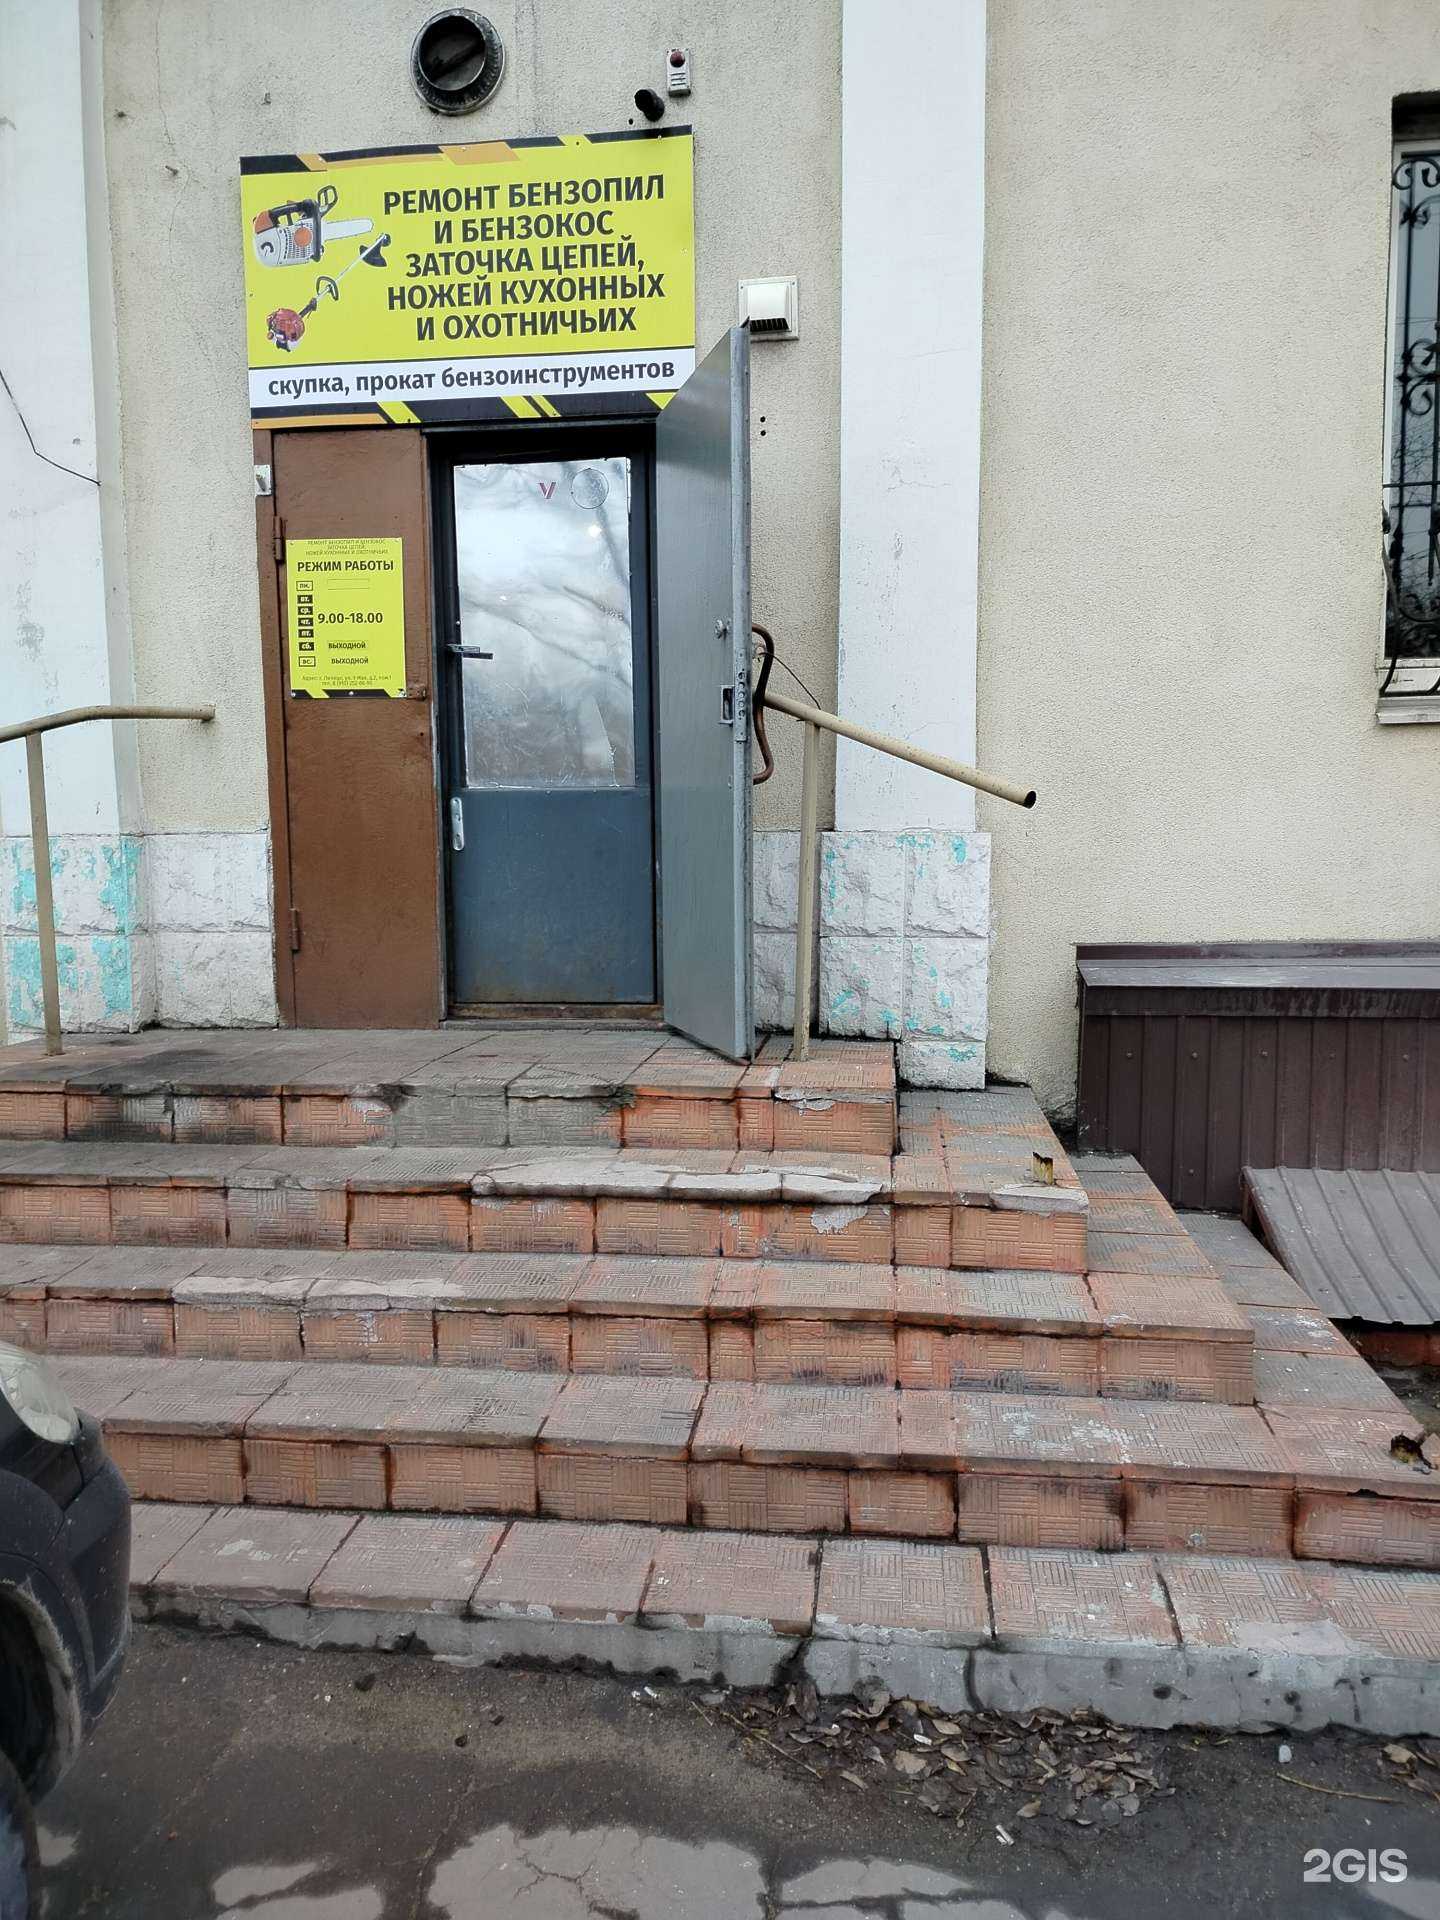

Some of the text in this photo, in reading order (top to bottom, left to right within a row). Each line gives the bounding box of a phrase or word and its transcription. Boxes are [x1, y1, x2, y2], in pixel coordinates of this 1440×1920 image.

[384, 174, 665, 215] РЕМОНТ БЕНЗОПИЛ
[434, 210, 614, 244] И БЕНЗОКОС
[405, 234, 645, 278] ЗАТОЧКА ЦЕПЕЙ,
[387, 273, 666, 310] НОЖЕЙ КУХОННЫХ
[416, 306, 637, 341] И ОХОТНИЧЬИХ
[268, 361, 675, 400] скупка, прокат бензоинструментов
[297, 560, 394, 572] РЕЖИМ РАБОТЫ
[317, 612, 383, 624] 9.00-18.00
